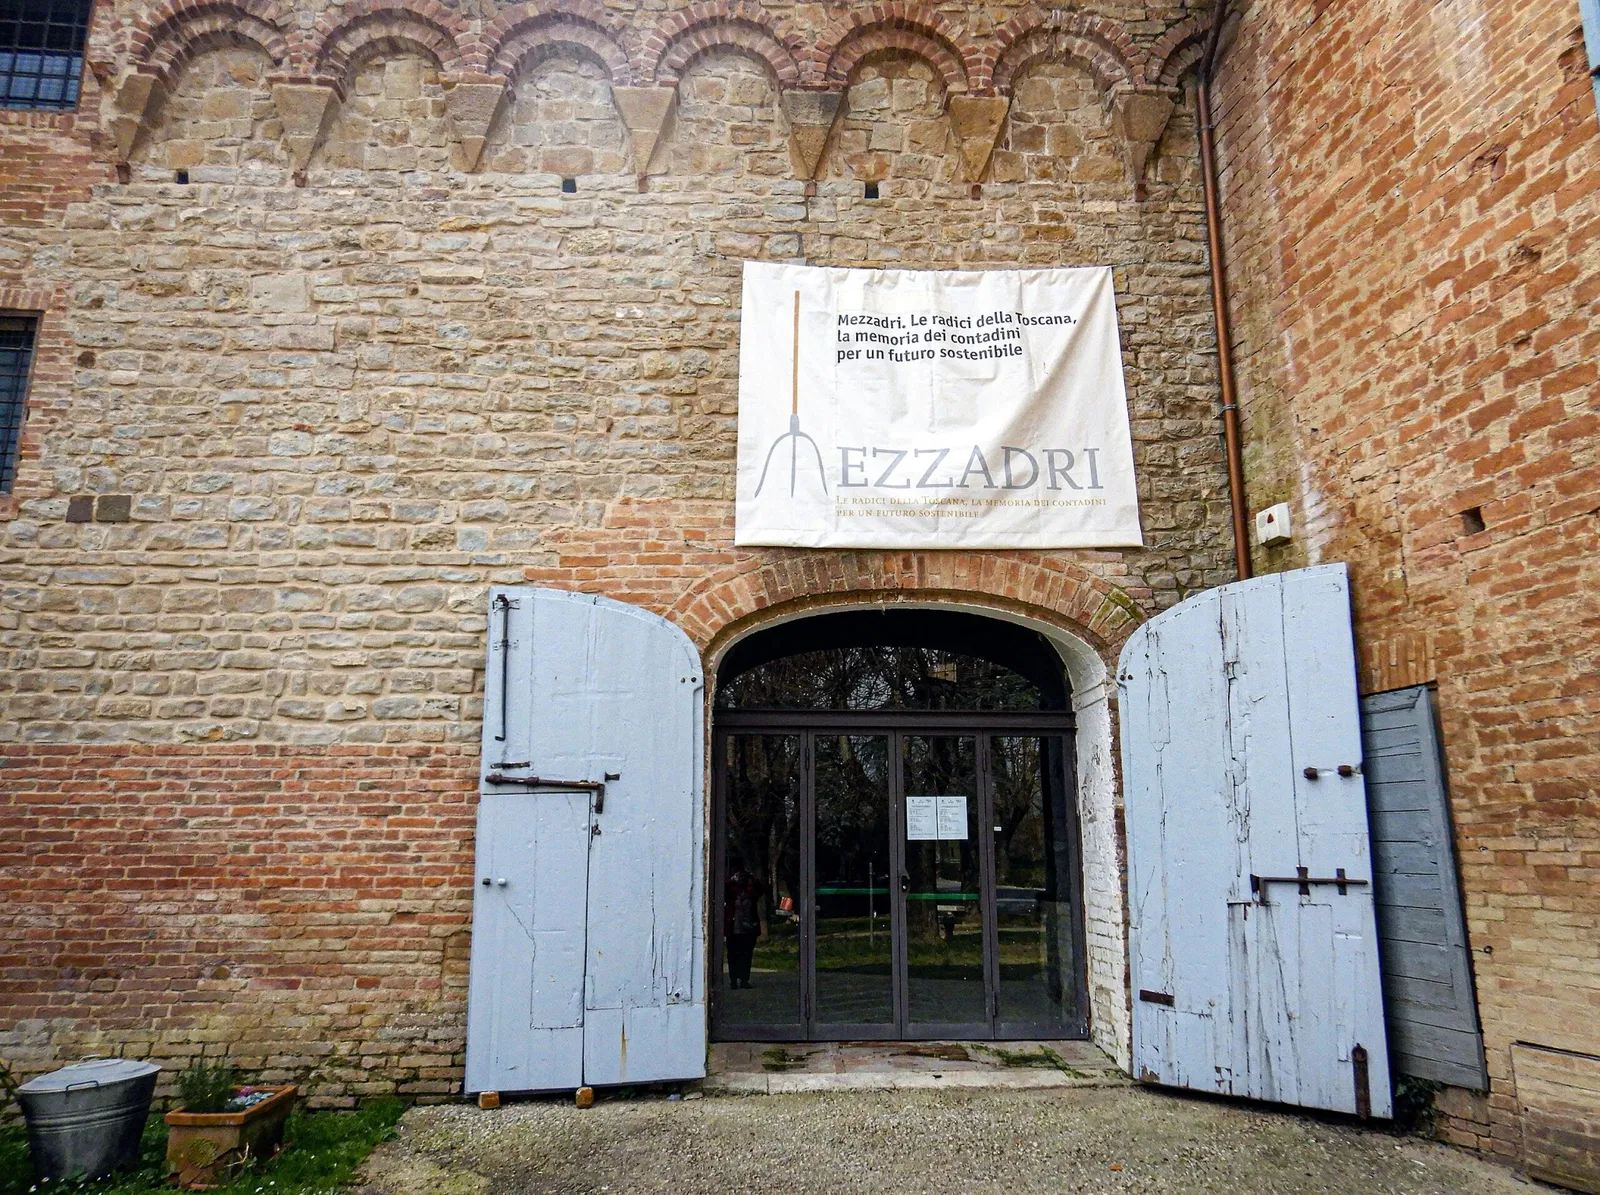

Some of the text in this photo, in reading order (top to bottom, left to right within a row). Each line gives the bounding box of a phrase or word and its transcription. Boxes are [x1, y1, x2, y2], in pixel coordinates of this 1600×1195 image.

[837, 311, 1077, 329] Mezzadri. Le radici della Toscana,
[837, 327, 1021, 345] la memoria dei contadini
[837, 344, 1023, 363] per un futuro sostenibile
[852, 497, 886, 505] RADICI
[971, 498, 982, 506] LA
[985, 499, 1031, 507] MEMORIA
[1034, 499, 1049, 507] DEI
[1052, 498, 1107, 507] CONTADINI
[836, 509, 980, 519] PER UN FUTURO SOSTENIBILE
